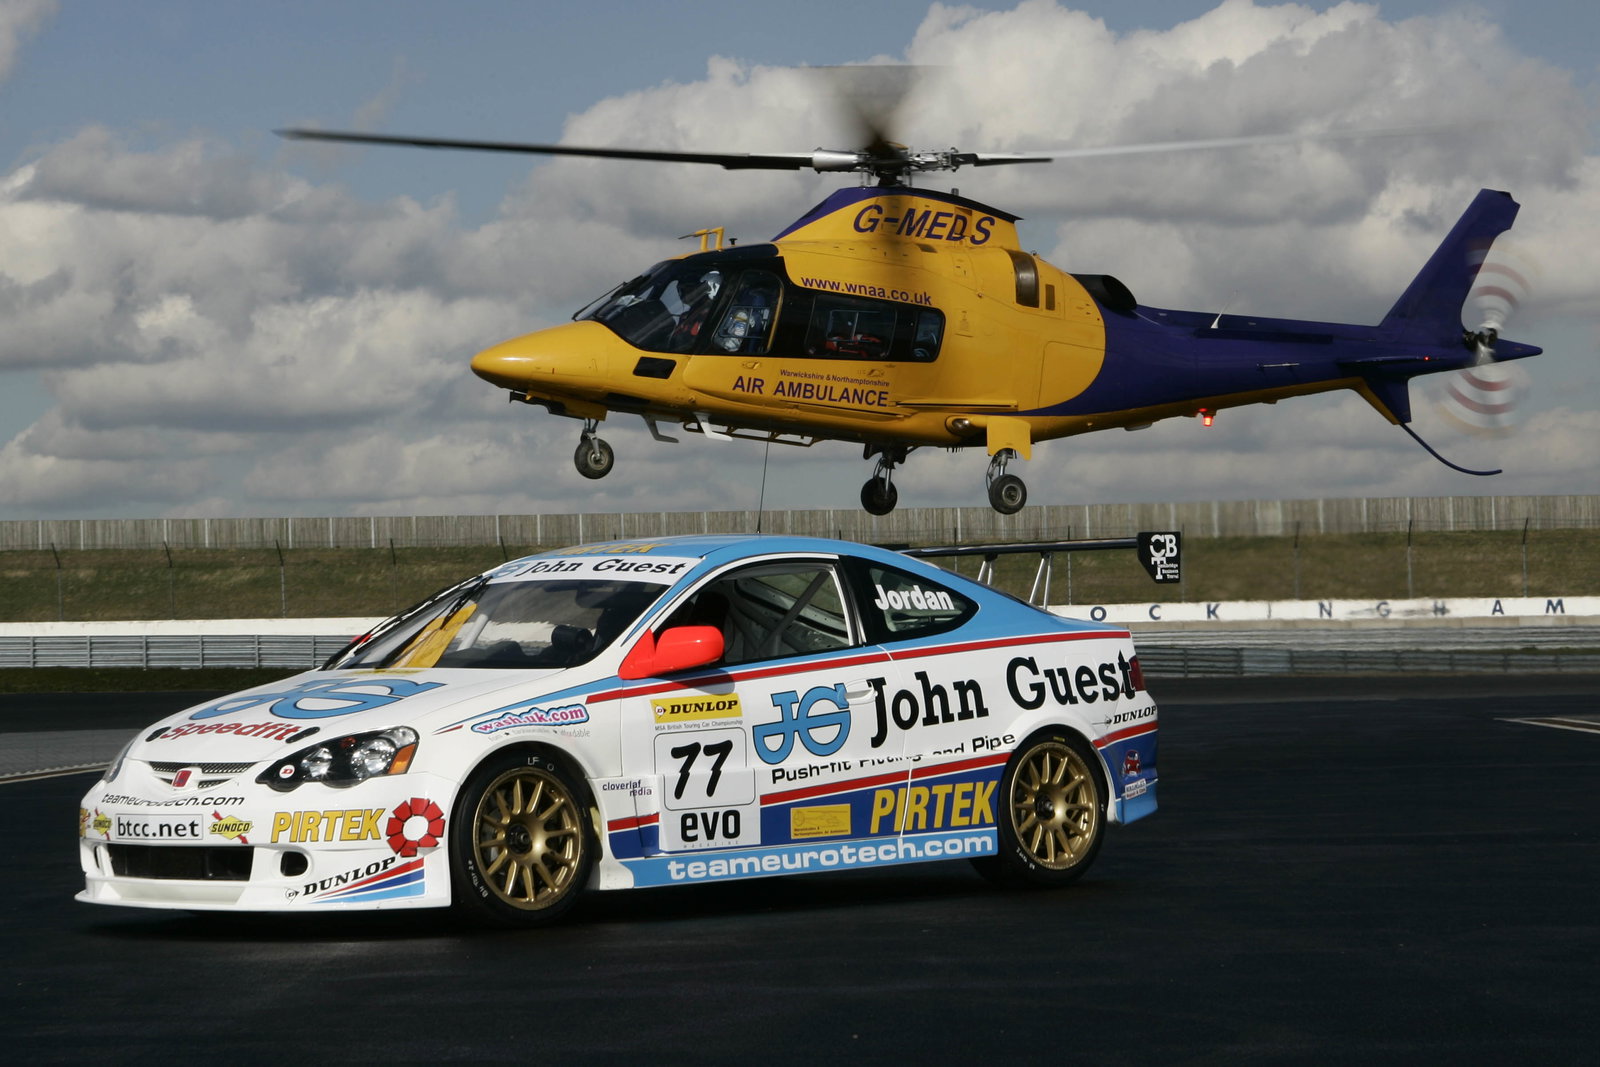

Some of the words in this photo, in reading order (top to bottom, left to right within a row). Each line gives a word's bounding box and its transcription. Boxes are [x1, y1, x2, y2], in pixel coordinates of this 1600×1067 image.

[853, 204, 996, 246] G-MEDS
[800, 275, 932, 306] www.wnaa.co.uk
[732, 376, 765, 394] AIR
[773, 381, 889, 407] AMBULANCE
[780, 369, 825, 381] Warwickshire
[826, 373, 831, 381] &
[832, 375, 890, 387] Northamptonshire
[514, 561, 583, 577] John
[592, 558, 687, 575] Guest
[874, 584, 955, 610] Jordan
[669, 700, 738, 714] DUNLOP
[867, 671, 989, 749] John
[1006, 650, 1137, 711] Guest
[478, 708, 585, 731] wash.uk.com
[1113, 705, 1156, 724] DUNLOP
[161, 721, 302, 741] Speedfit
[972, 733, 1016, 753] Pipe
[670, 740, 733, 800] 77
[870, 780, 998, 834] PIRTEK
[117, 817, 199, 838] btcc.net
[211, 823, 251, 833] SUNOCO
[271, 808, 386, 843] PIRTEK
[681, 809, 741, 842] evo
[668, 835, 993, 880] teameurotech.com
[303, 856, 397, 896] DUNLOP
